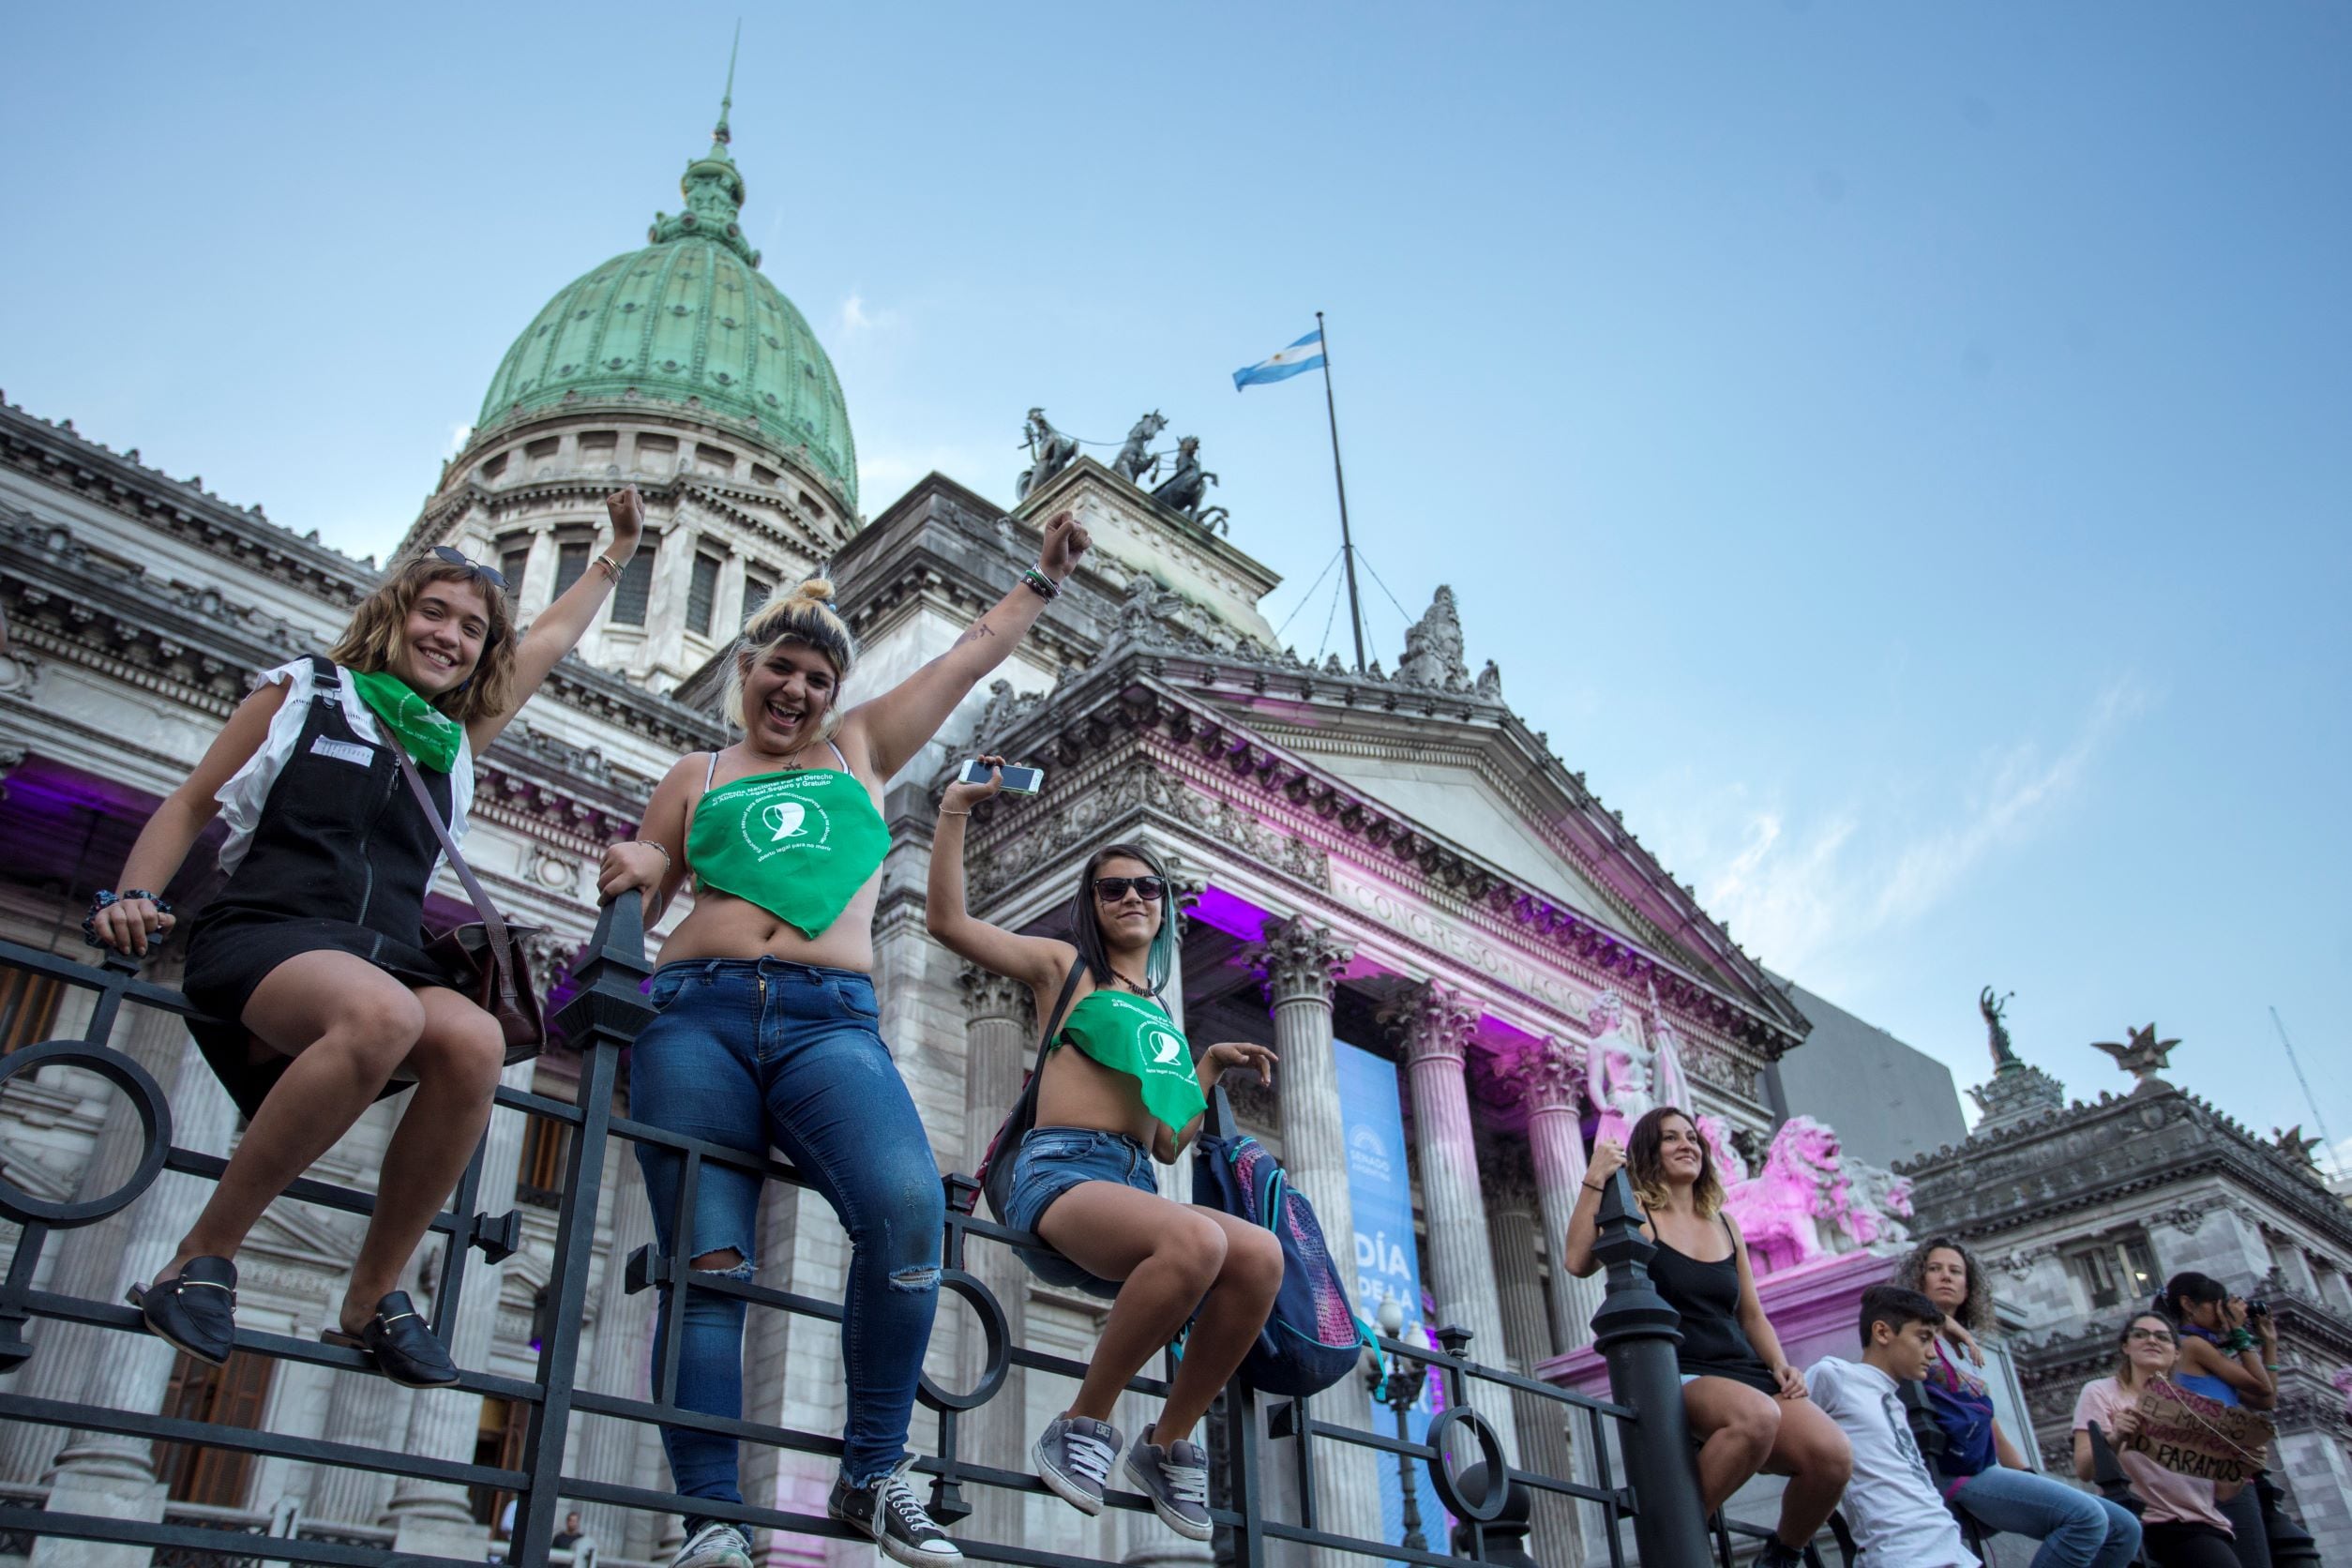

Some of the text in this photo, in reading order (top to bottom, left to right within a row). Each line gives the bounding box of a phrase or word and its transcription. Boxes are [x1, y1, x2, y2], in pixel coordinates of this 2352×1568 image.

[768, 783, 794, 792] Seguro
[776, 844, 792, 852] legal
[1355, 885, 1592, 1022] CONGRESO NACIO
[1353, 1230, 1411, 1281] DÍA
[1358, 1276, 1384, 1302] DE
[2140, 1395, 2246, 1440] EL MUNDO
[2157, 1444, 2242, 1483] PARAMOS
